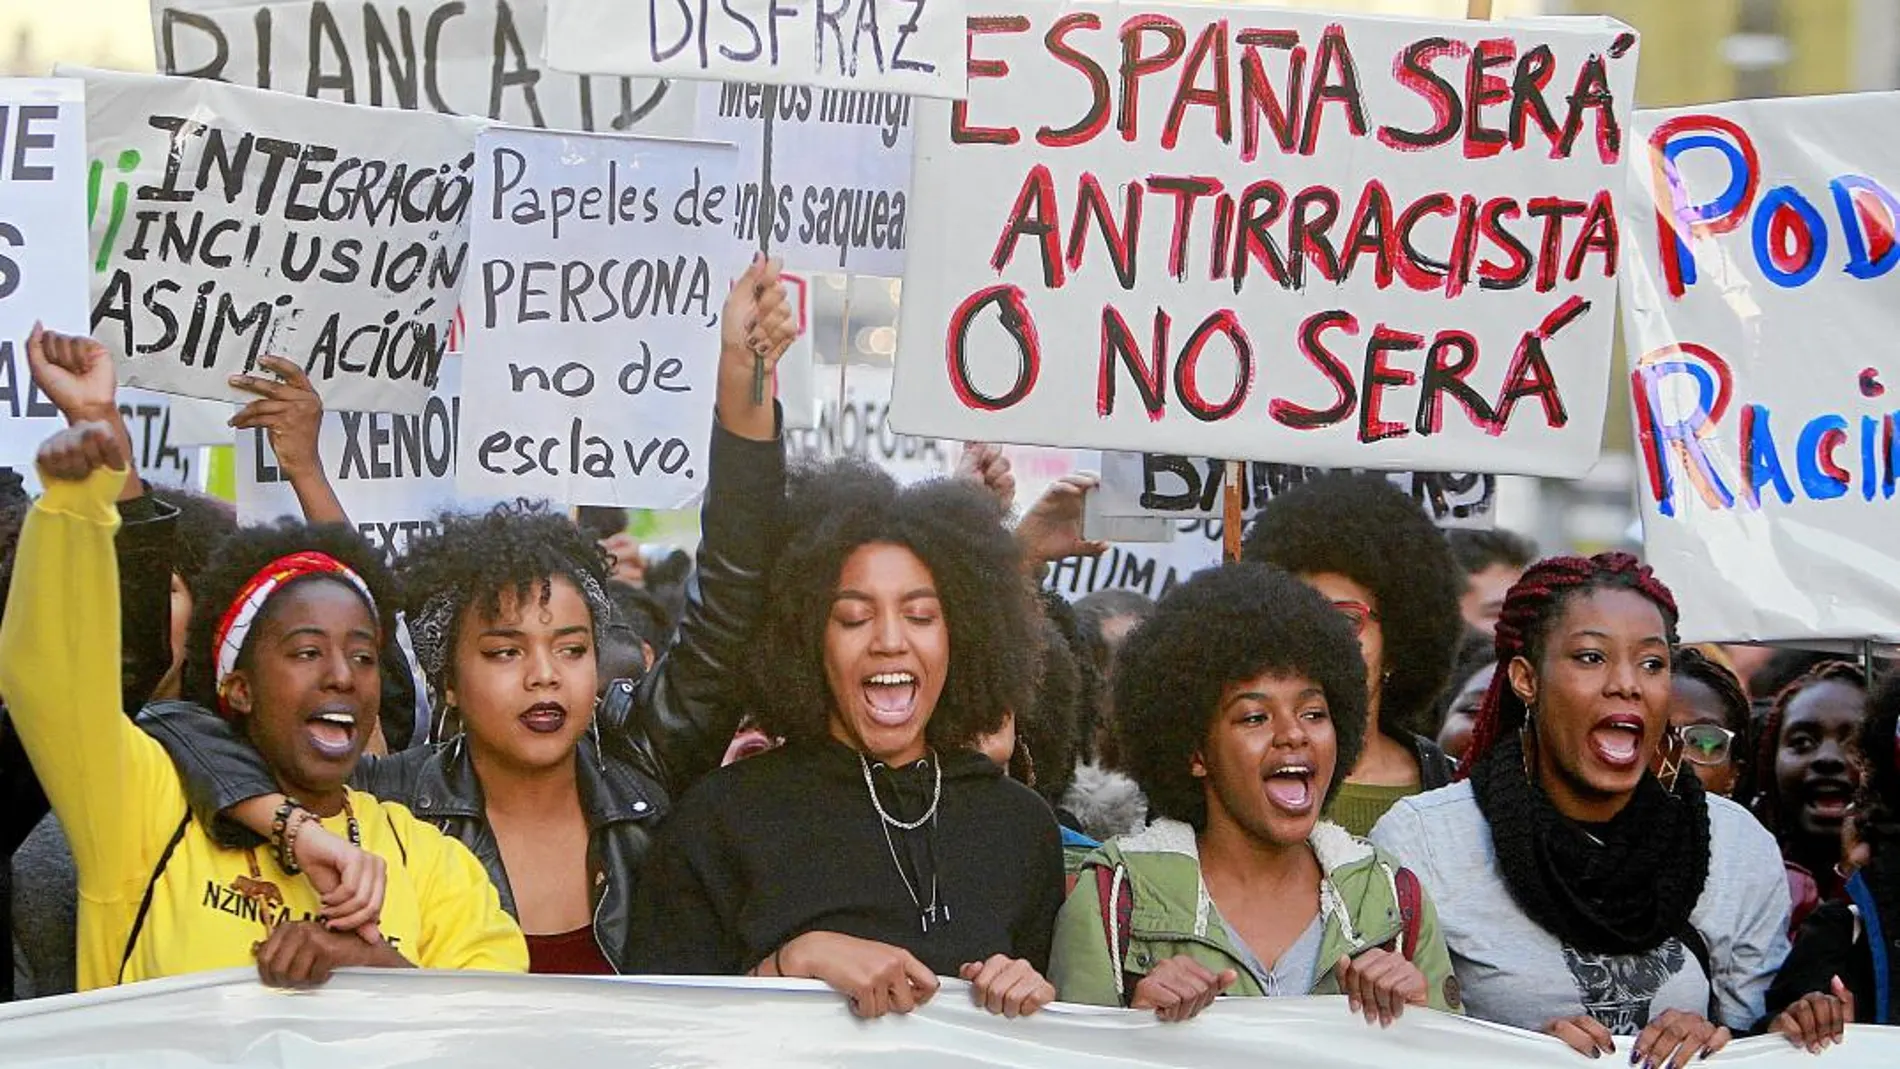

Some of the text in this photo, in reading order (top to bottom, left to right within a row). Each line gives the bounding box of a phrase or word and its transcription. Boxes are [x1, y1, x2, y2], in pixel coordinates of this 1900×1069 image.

[649, 0, 936, 77] DISFRAZ
[951, 14, 1635, 163] ESPAÑA SERÁ
[492, 148, 726, 239] Papeles de
[990, 164, 1619, 297] ANTIRRACISTA
[483, 255, 718, 329] PERSONA,
[509, 341, 691, 397] no de
[947, 285, 1592, 443] O NO SERÁ
[338, 396, 461, 480] XENO
[478, 418, 693, 479] esclavo.
